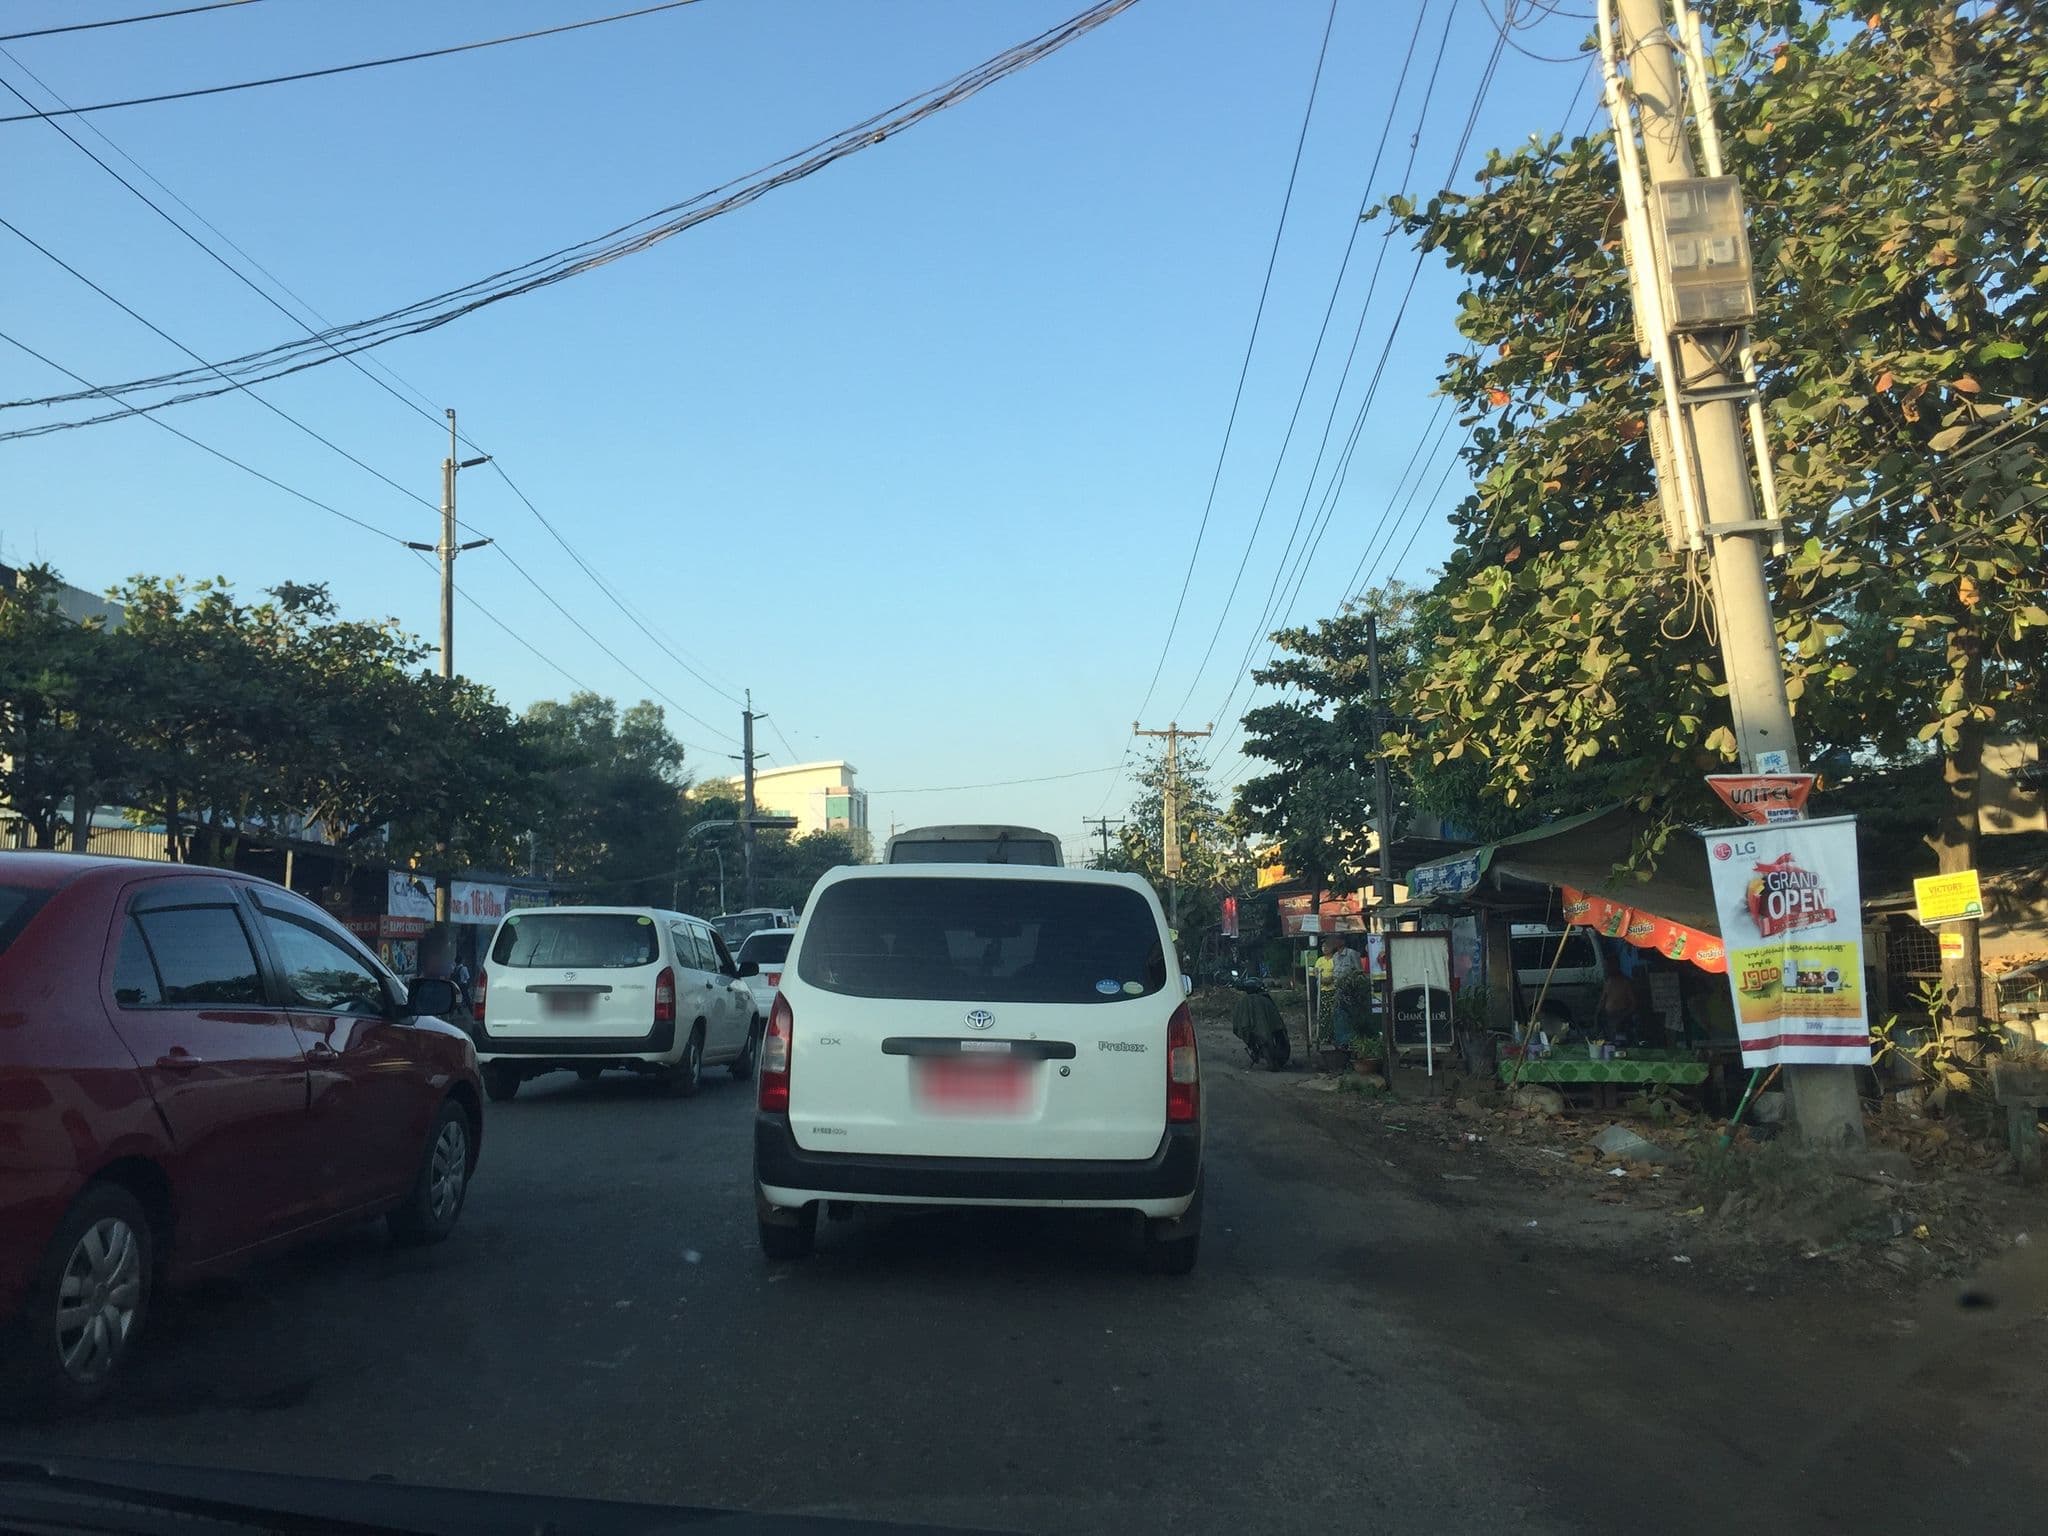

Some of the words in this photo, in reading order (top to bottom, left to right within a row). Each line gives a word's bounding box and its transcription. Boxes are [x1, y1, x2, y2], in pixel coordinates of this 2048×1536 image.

[1731, 787, 1793, 804] UNITEL
[1735, 841, 1756, 856] LG
[1767, 871, 1819, 891] GRAND
[1768, 888, 1826, 920] OPEN
[1627, 923, 1655, 936] Sunkist
[1098, 1040, 1145, 1052] Probox
